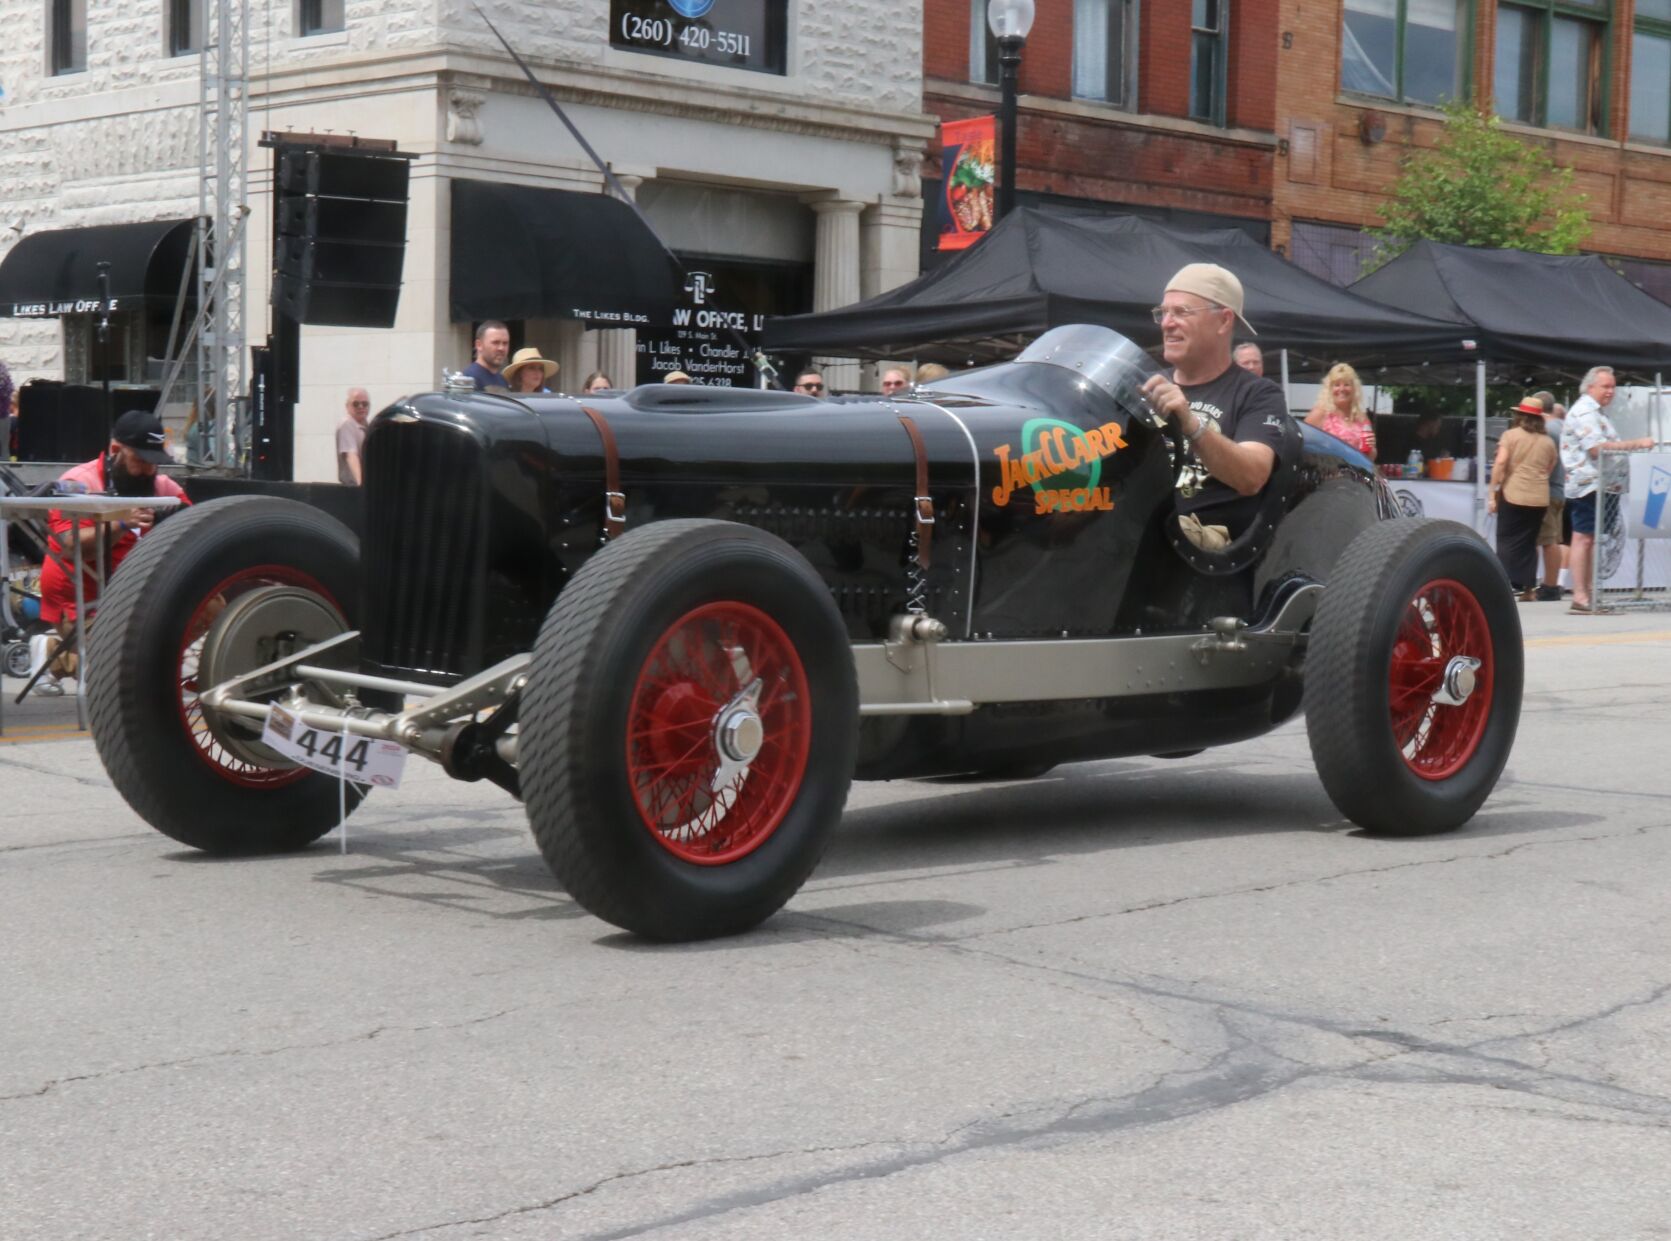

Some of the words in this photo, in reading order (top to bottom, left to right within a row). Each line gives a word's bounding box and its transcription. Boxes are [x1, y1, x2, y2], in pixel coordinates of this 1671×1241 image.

[622, 12, 673, 46] (260)
[679, 26, 751, 56] 420-5511
[13, 303, 46, 316] LIKES
[48, 302, 74, 314] LAW
[75, 299, 118, 312] OFFE
[573, 308, 592, 319] THE
[594, 310, 621, 320] LIKES
[659, 340, 681, 355] Likes
[699, 342, 740, 358] Chandler
[651, 357, 682, 371] Jacob
[685, 358, 745, 374] VanderHorst
[1034, 487, 1114, 515] SPECIAL
[296, 729, 370, 772] 444
